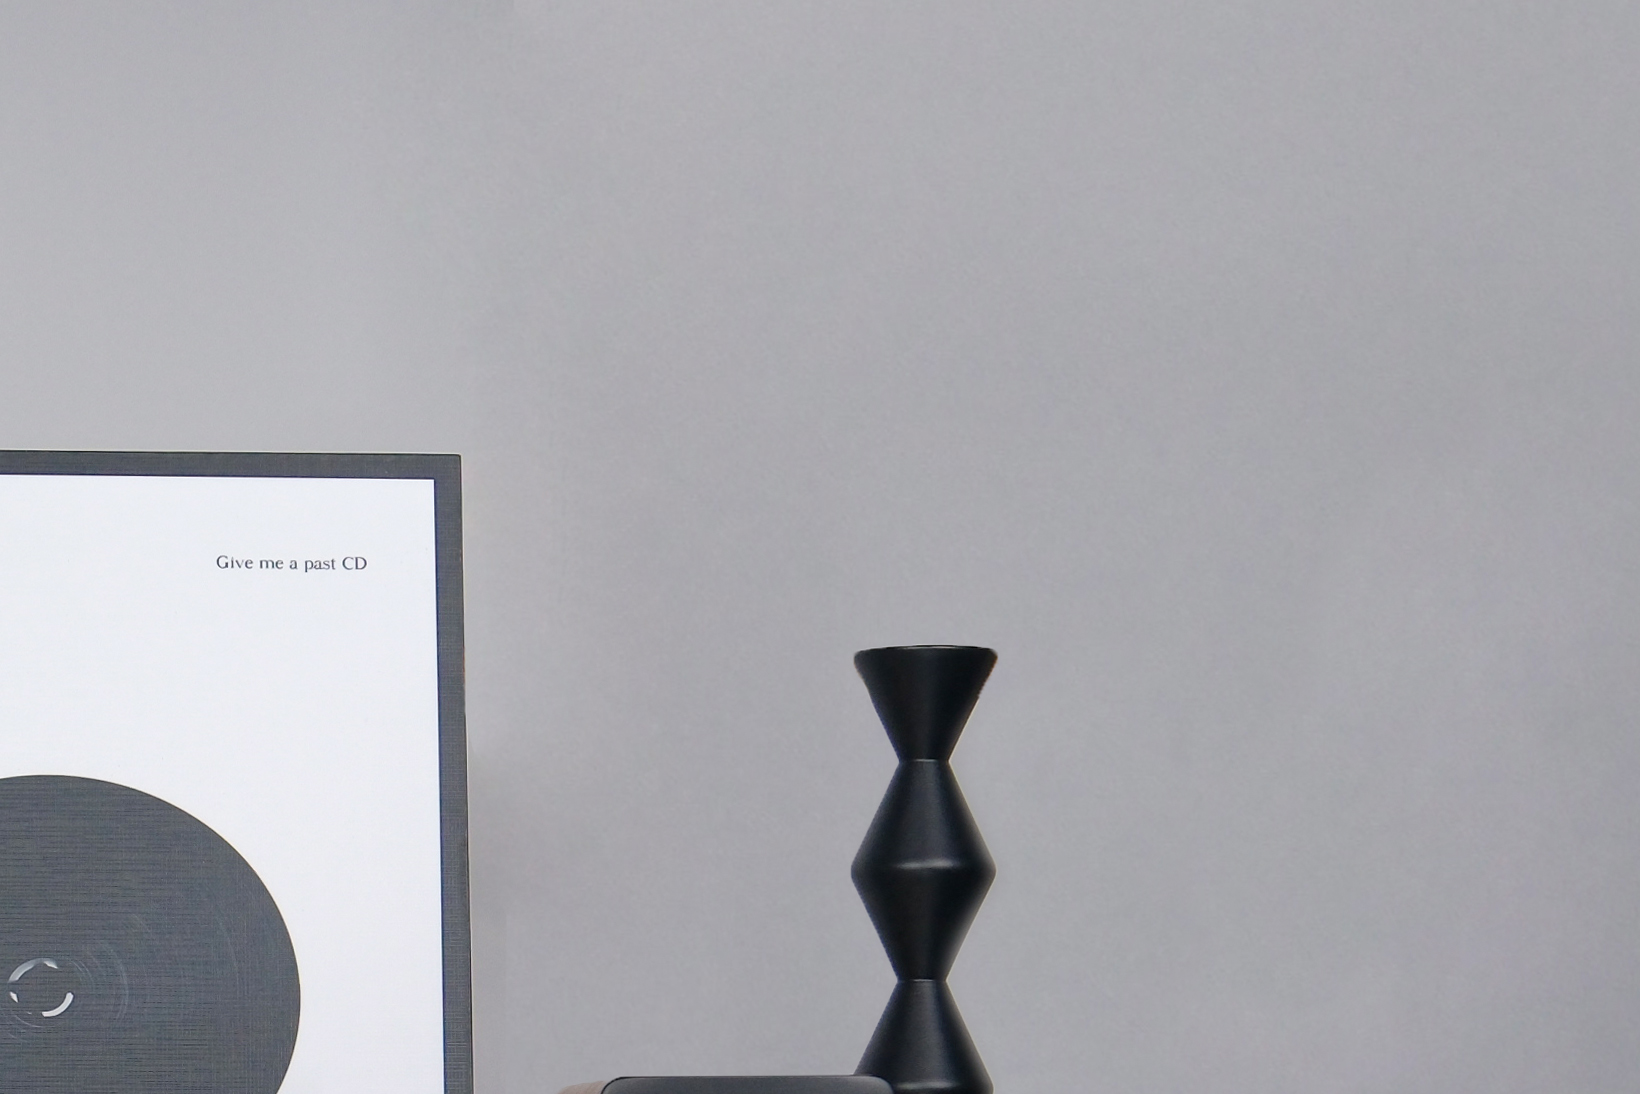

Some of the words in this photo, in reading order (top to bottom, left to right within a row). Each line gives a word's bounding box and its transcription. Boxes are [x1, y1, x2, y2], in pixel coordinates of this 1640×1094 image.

[216, 555, 253, 569] Give
[259, 559, 284, 570] me
[289, 559, 298, 570] a
[304, 558, 336, 573] past
[342, 556, 367, 570] CD
